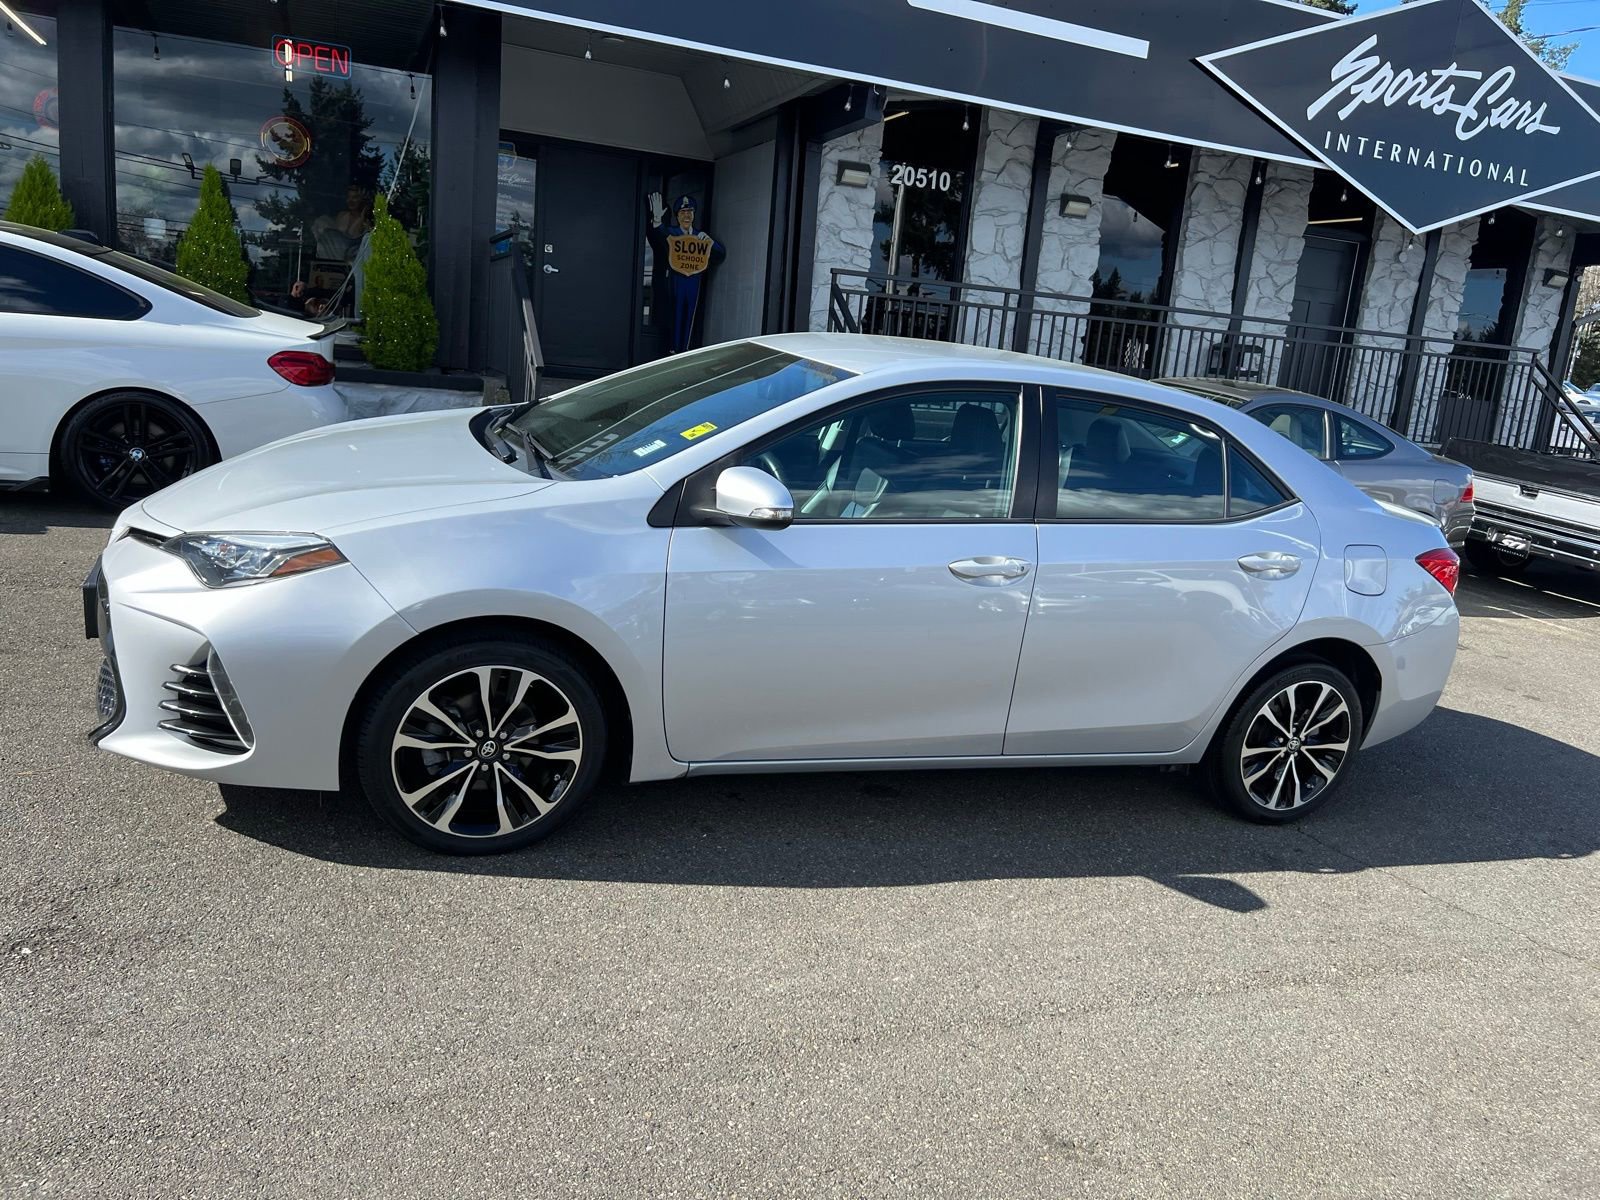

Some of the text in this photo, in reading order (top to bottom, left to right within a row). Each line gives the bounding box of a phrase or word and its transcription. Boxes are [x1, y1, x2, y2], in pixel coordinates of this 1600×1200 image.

[275, 40, 348, 75] OPEN
[1306, 34, 1560, 141] Sports Cars
[1324, 130, 1529, 187] INTERNATIONAL
[890, 164, 951, 192] 20510
[674, 240, 709, 256] SLOW
[677, 254, 705, 264] SCHOOL
[680, 262, 700, 271] ZONE
